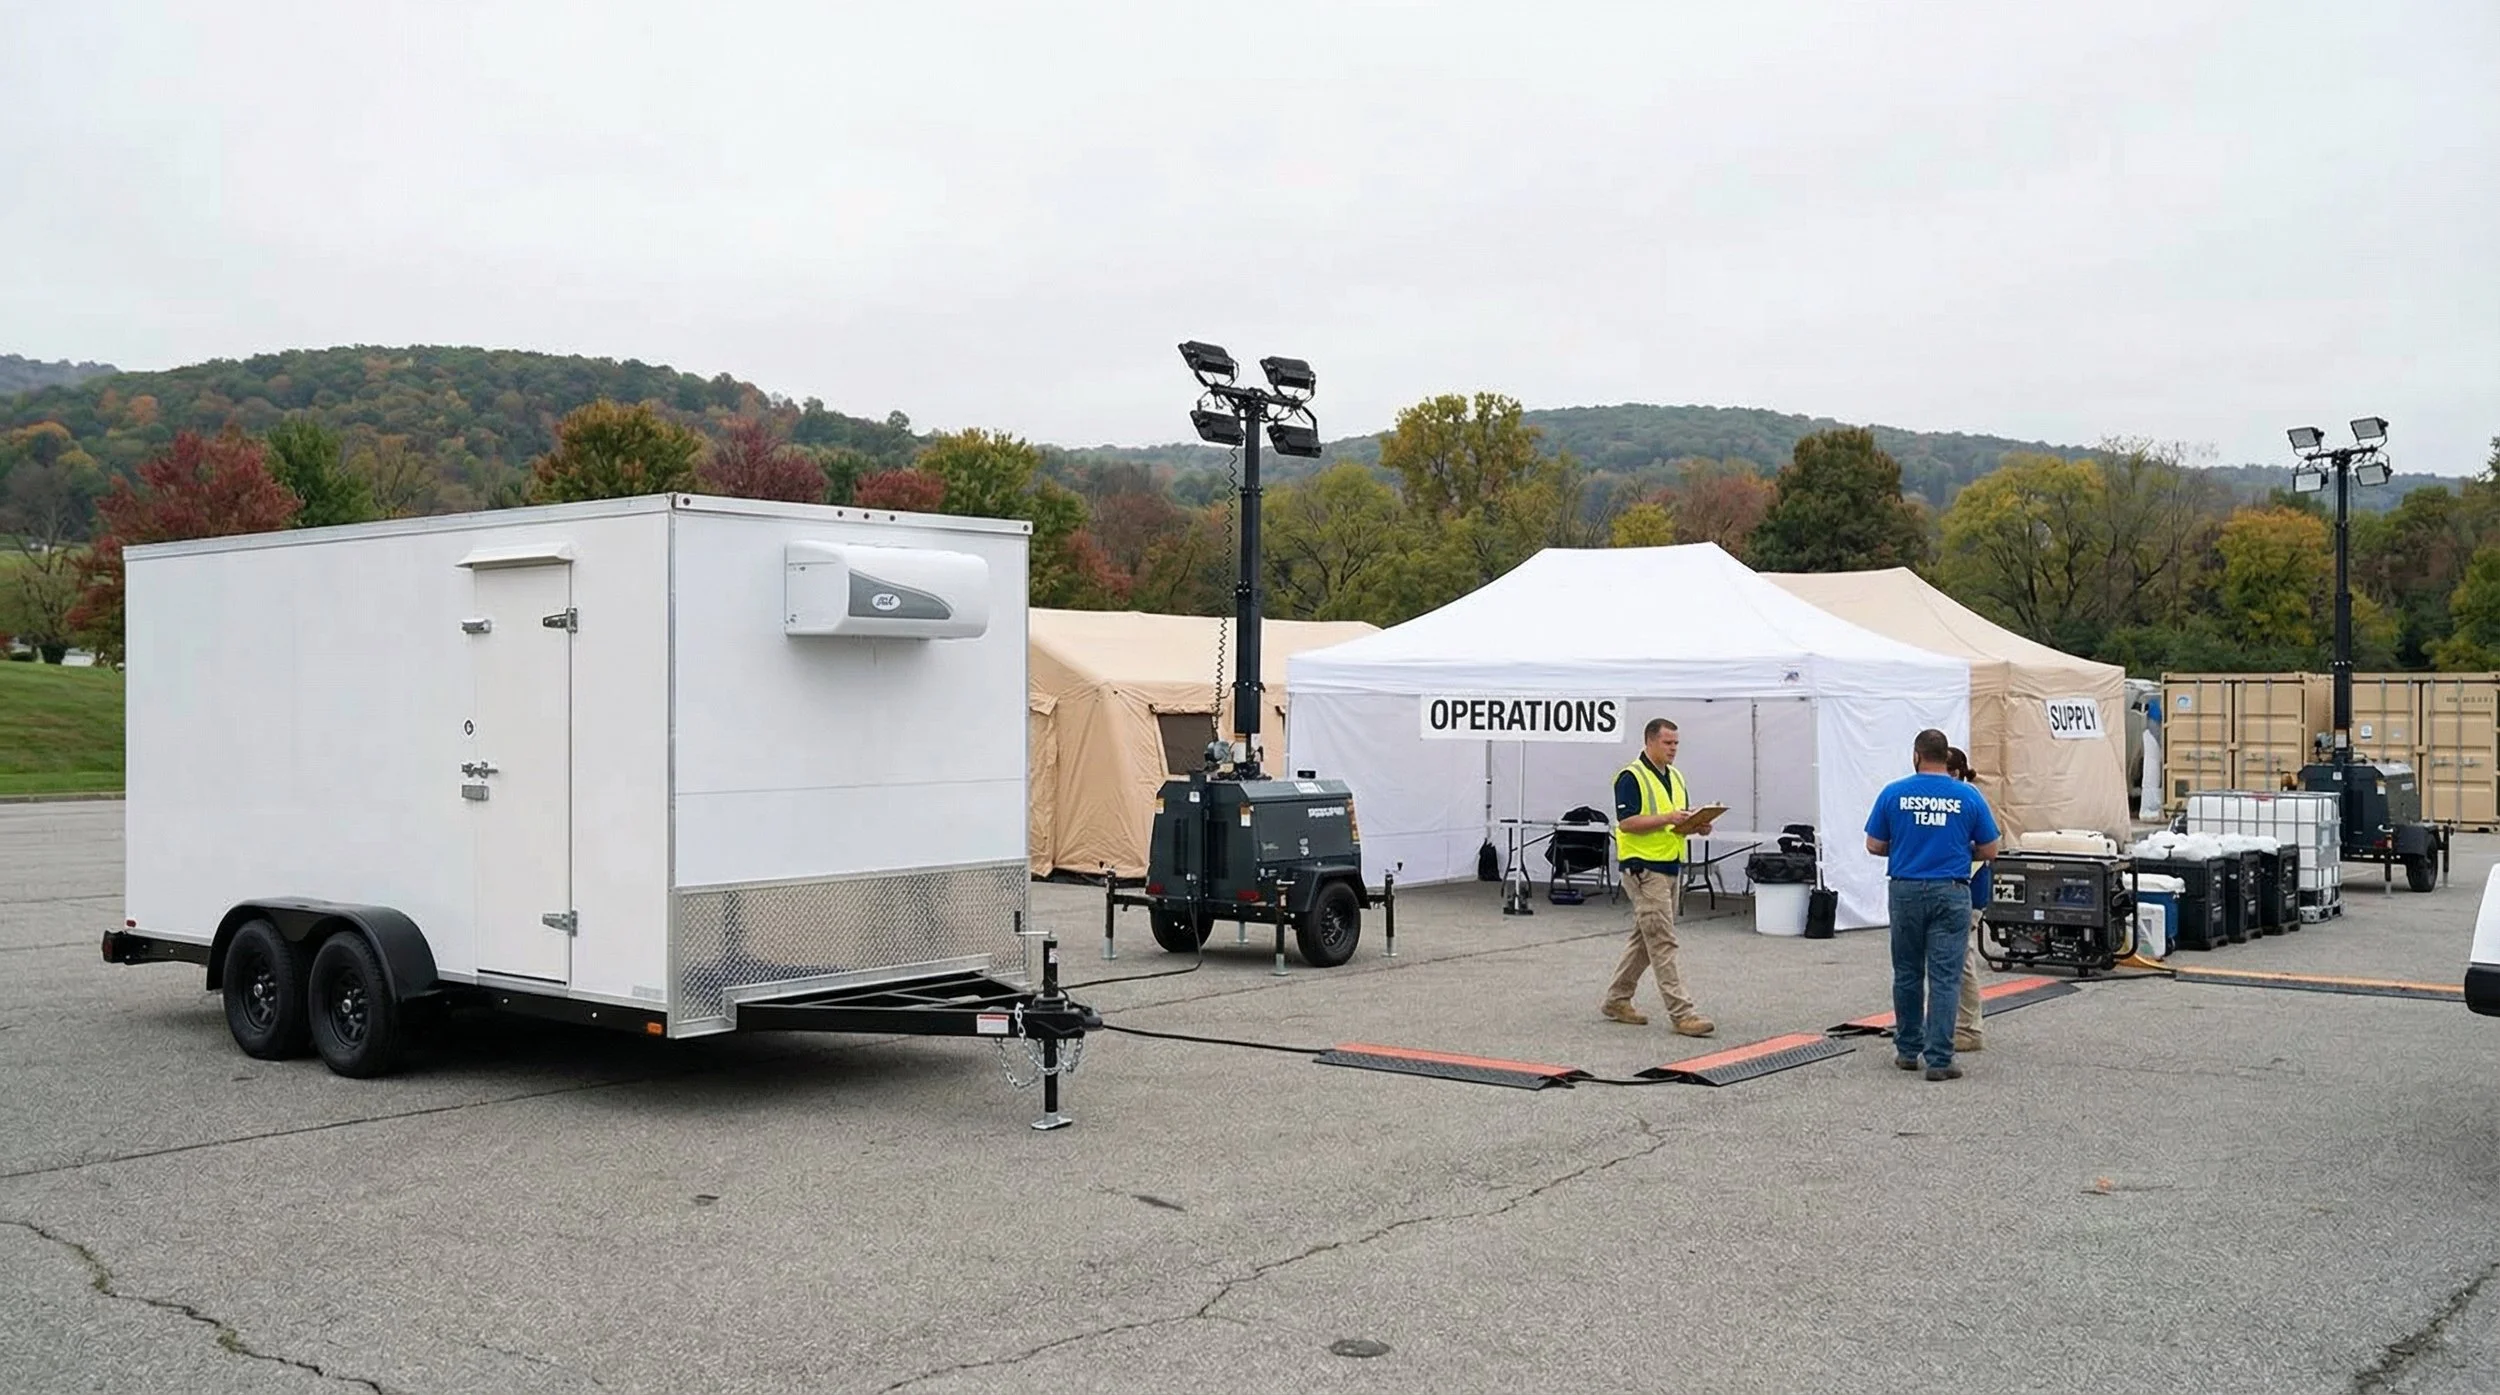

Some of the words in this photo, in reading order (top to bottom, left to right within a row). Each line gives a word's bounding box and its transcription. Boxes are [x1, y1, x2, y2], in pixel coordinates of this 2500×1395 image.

[1431, 699, 1616, 733] OPERATIONS
[2050, 705, 2096, 731] SUPPLY
[1900, 796, 1962, 813] RESPONSE
[1913, 811, 1947, 826] TEAM
